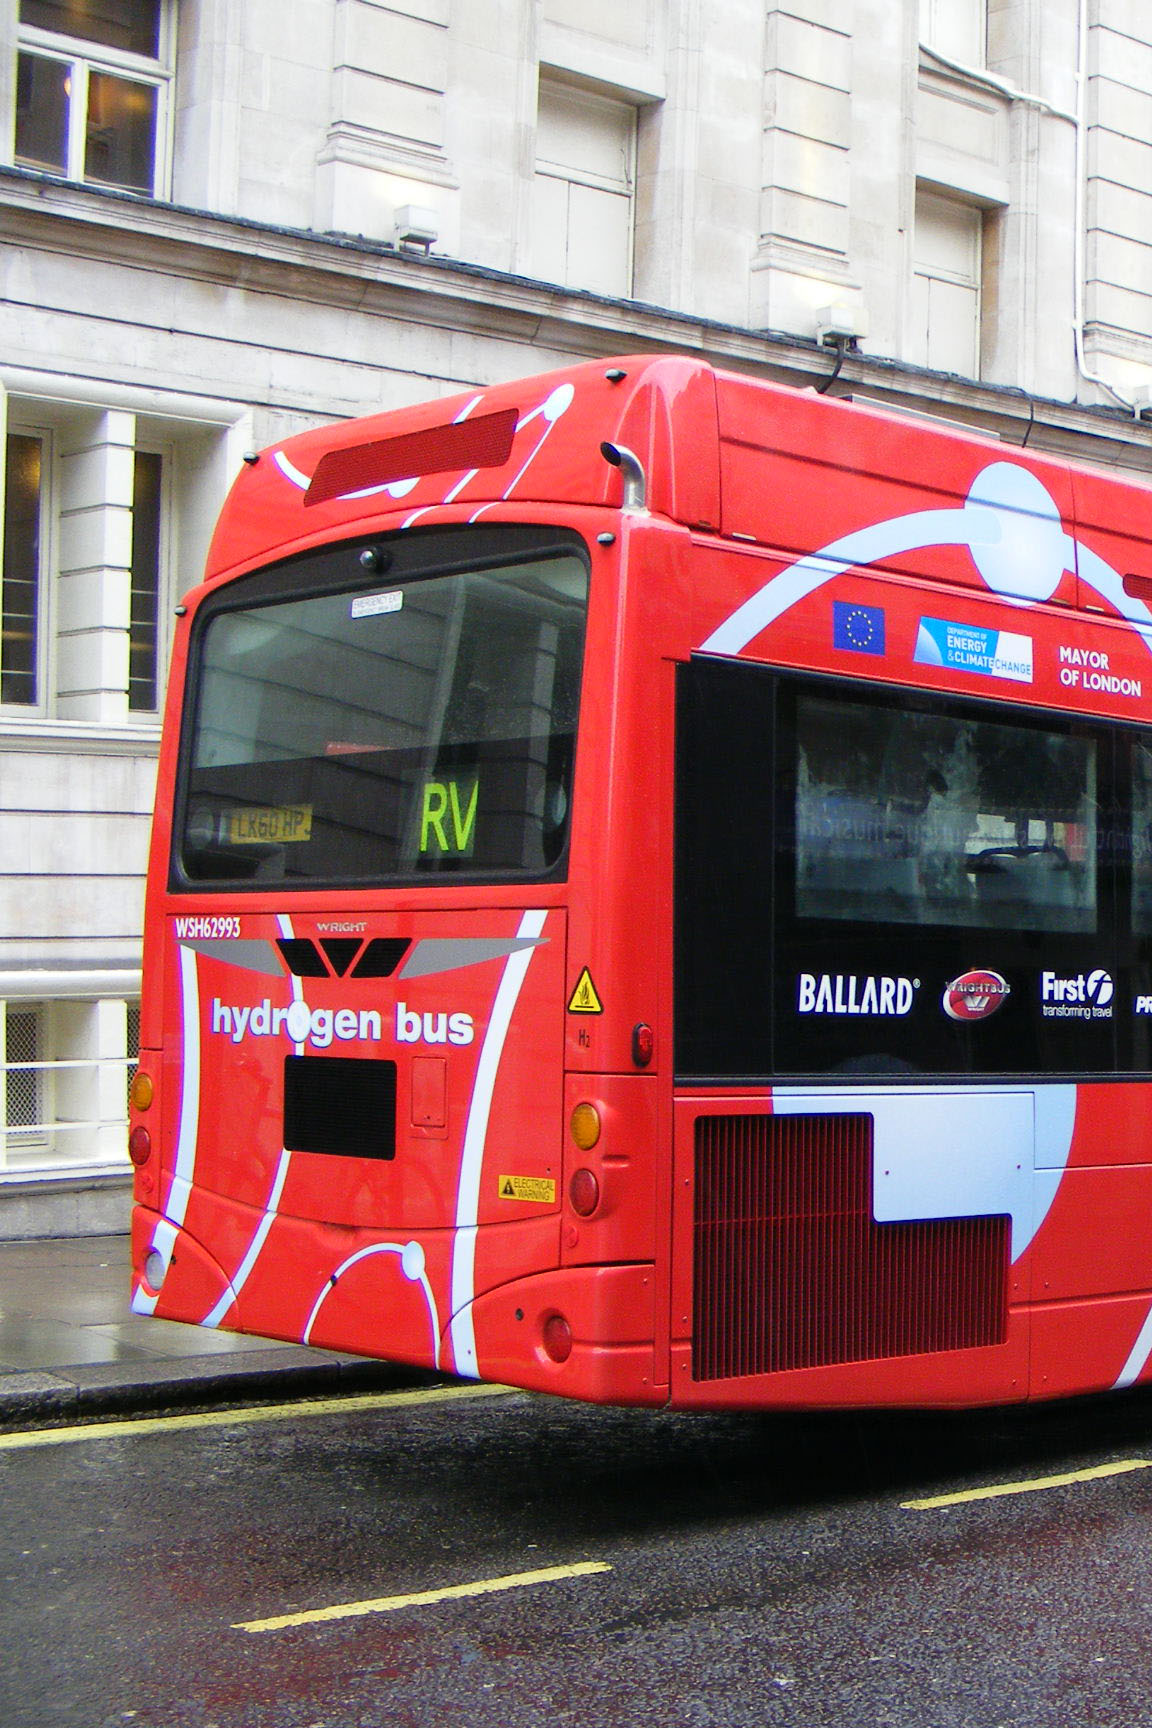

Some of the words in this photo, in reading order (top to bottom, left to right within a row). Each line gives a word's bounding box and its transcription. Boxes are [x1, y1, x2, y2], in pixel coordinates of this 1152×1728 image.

[947, 635, 987, 654] ENERGY
[1059, 646, 1110, 670] MAYOR
[1060, 668, 1080, 686] OF
[1082, 672, 1142, 697] LONDON
[420, 780, 479, 852] RV
[175, 917, 241, 938] WSH62993
[317, 922, 367, 933] WRIGHT
[945, 981, 1011, 995] WRIGHTBUS
[1042, 971, 1086, 1001] First
[211, 997, 382, 1047] hydrogen
[396, 1002, 475, 1045] bus
[1043, 1004, 1091, 1020] transforming
[1092, 1004, 1113, 1018] travel
[513, 1177, 554, 1191] ELECTRICAL
[517, 1188, 550, 1201] WARNING
